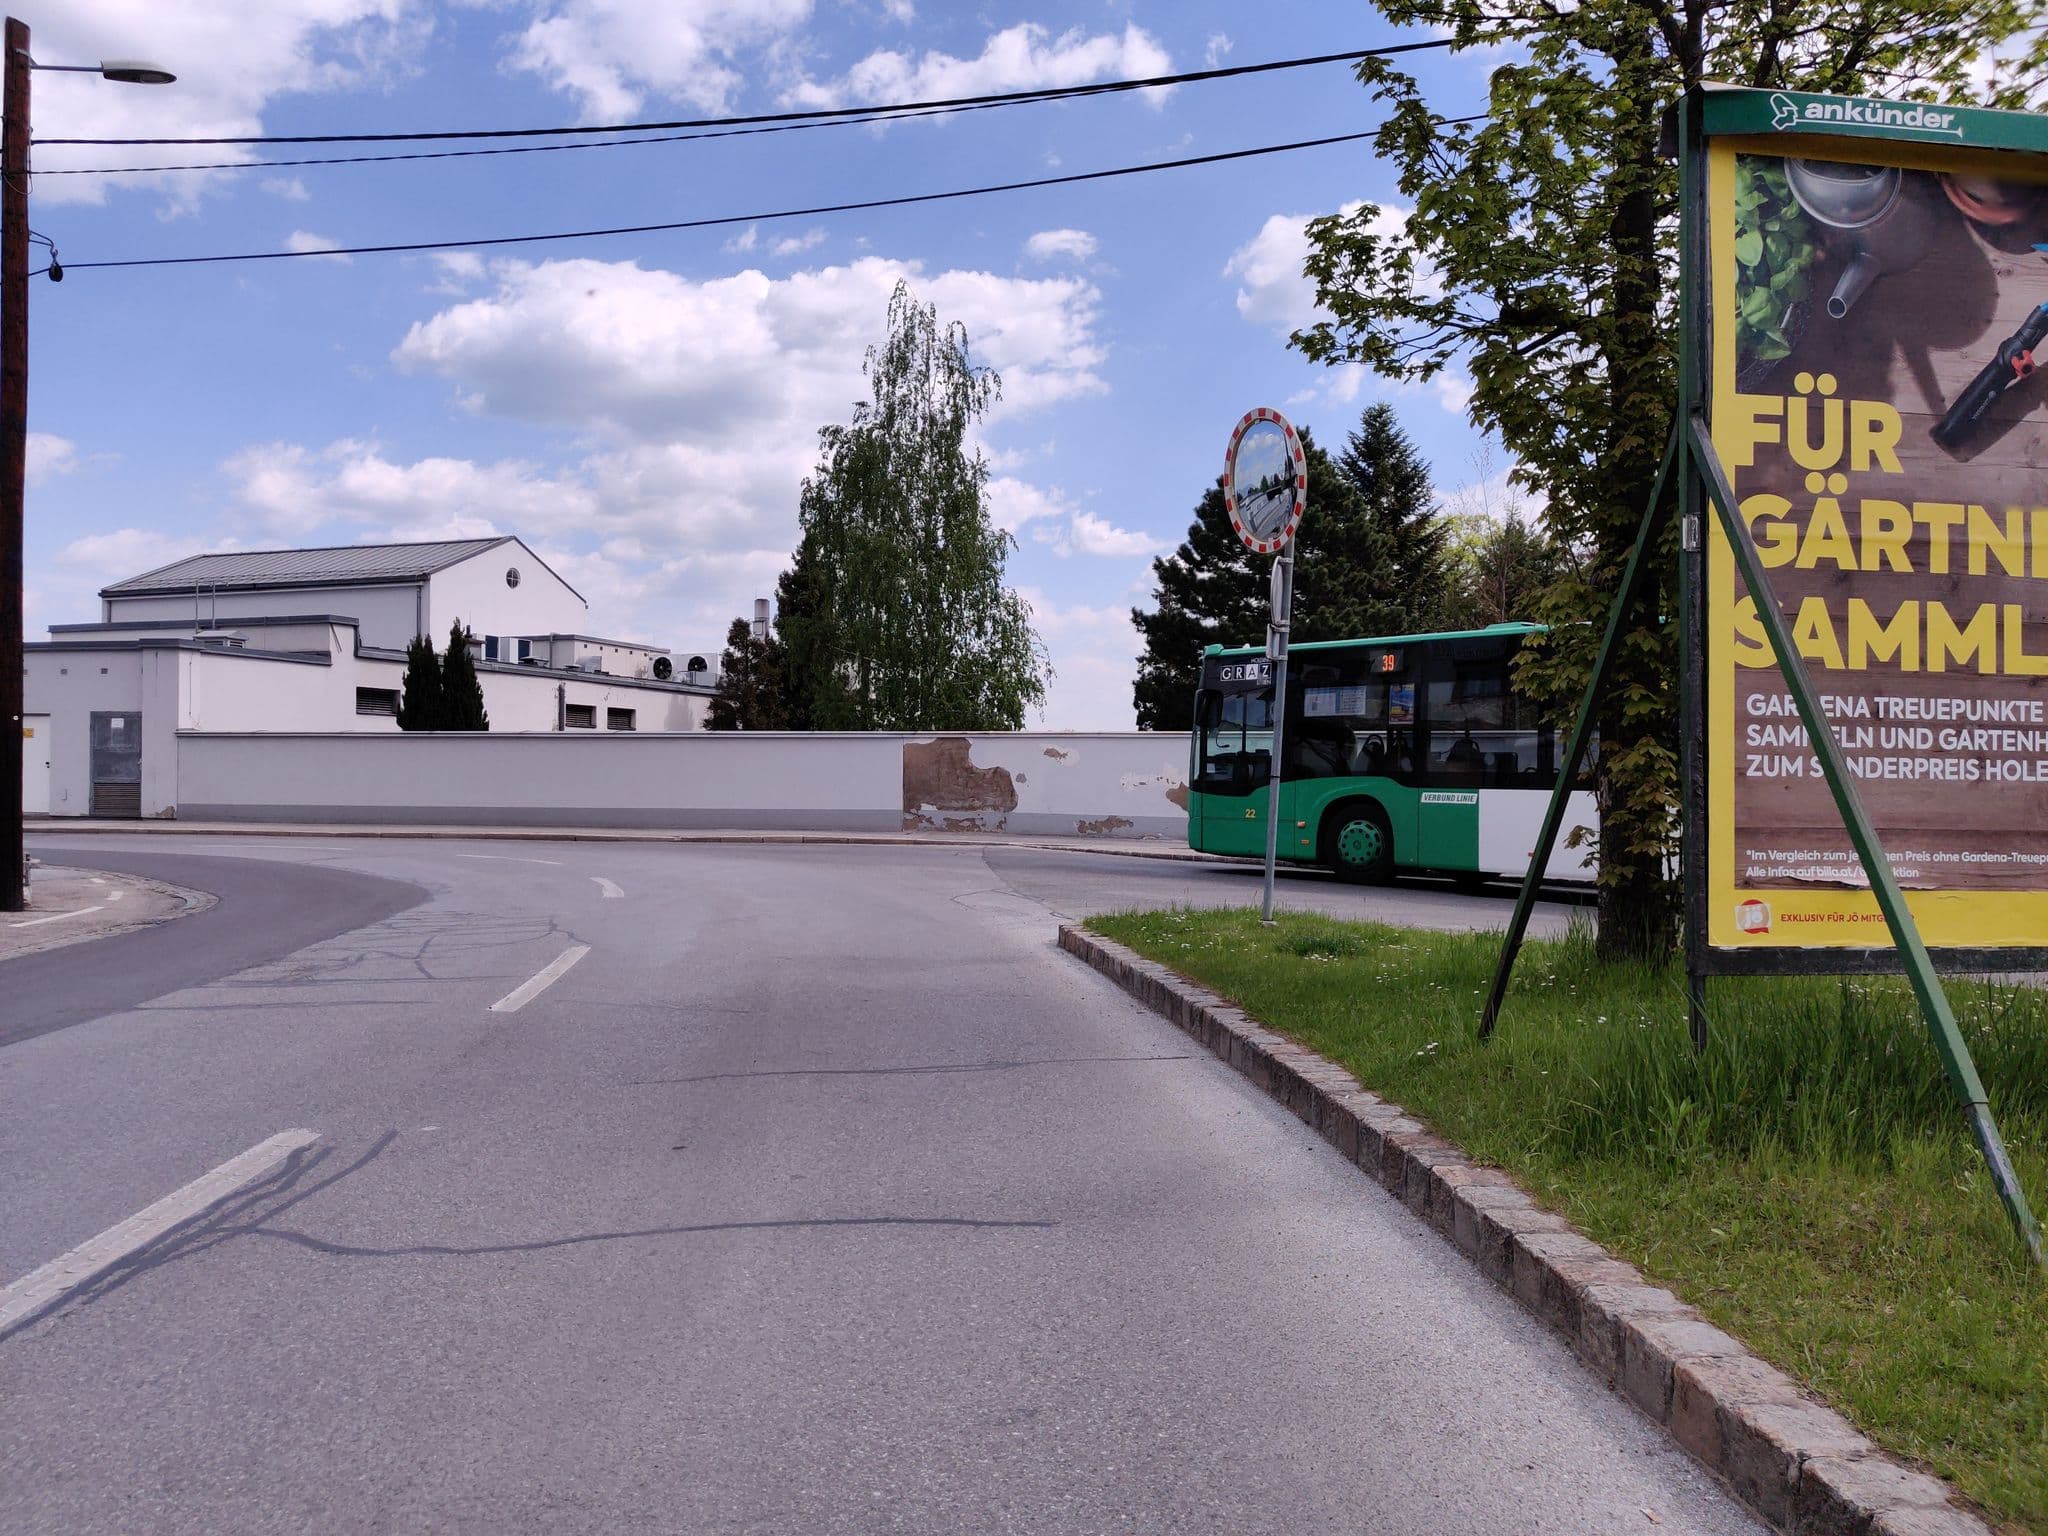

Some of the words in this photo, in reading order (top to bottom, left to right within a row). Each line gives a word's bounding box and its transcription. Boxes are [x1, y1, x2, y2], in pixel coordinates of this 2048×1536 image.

[1804, 100, 1955, 129] ankünder
[1735, 371, 1904, 474] FÜR
[1382, 654, 1395, 671] 39
[1221, 664, 1271, 680] GRAZ
[1746, 693, 1871, 718] GARENA
[1873, 696, 2044, 722] TREUEPUNKTE
[1880, 727, 1933, 749] UND
[1746, 754, 1803, 778] ZUM
[1809, 755, 1980, 780] SNDERPREIS
[1424, 793, 1456, 802] VERBUND
[1456, 794, 1476, 803] LINIE
[1245, 808, 1256, 818] 22
[1769, 850, 1821, 863] Vergleich
[1823, 851, 1846, 861] zum
[1905, 851, 1931, 862] Preis
[1932, 852, 1959, 862] ohne
[1745, 866, 1767, 877] Alle
[1768, 866, 1795, 877] Infos
[1796, 866, 1814, 877] auf
[1781, 913, 1825, 922] EXKLUSIV
[1828, 911, 1844, 922] FÜR
[1846, 911, 1859, 922] JÖ
